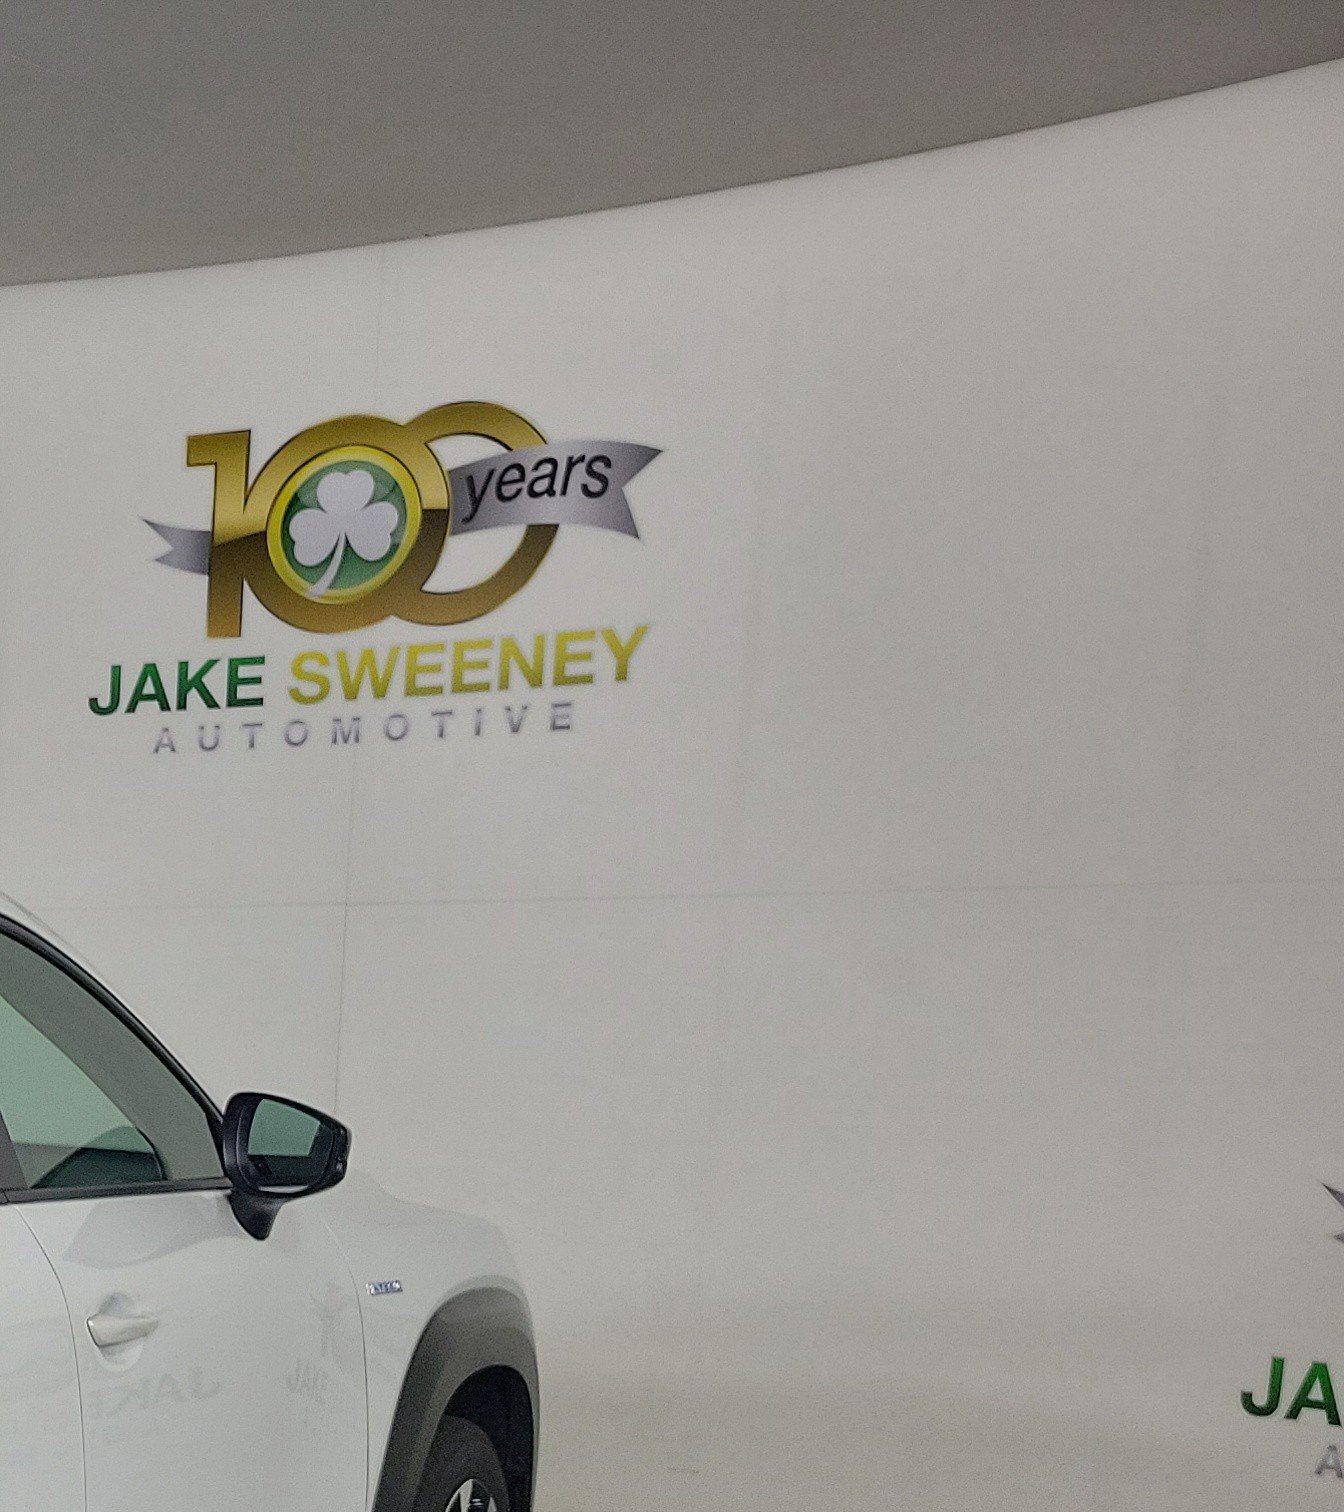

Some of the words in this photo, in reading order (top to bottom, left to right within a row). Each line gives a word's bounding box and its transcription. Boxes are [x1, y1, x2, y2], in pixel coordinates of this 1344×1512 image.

[187, 400, 559, 638] 100
[462, 450, 613, 523] years
[88, 655, 266, 716] JAKE
[288, 625, 650, 706] SWEENEY
[152, 702, 576, 754] AUTOMOTIVE
